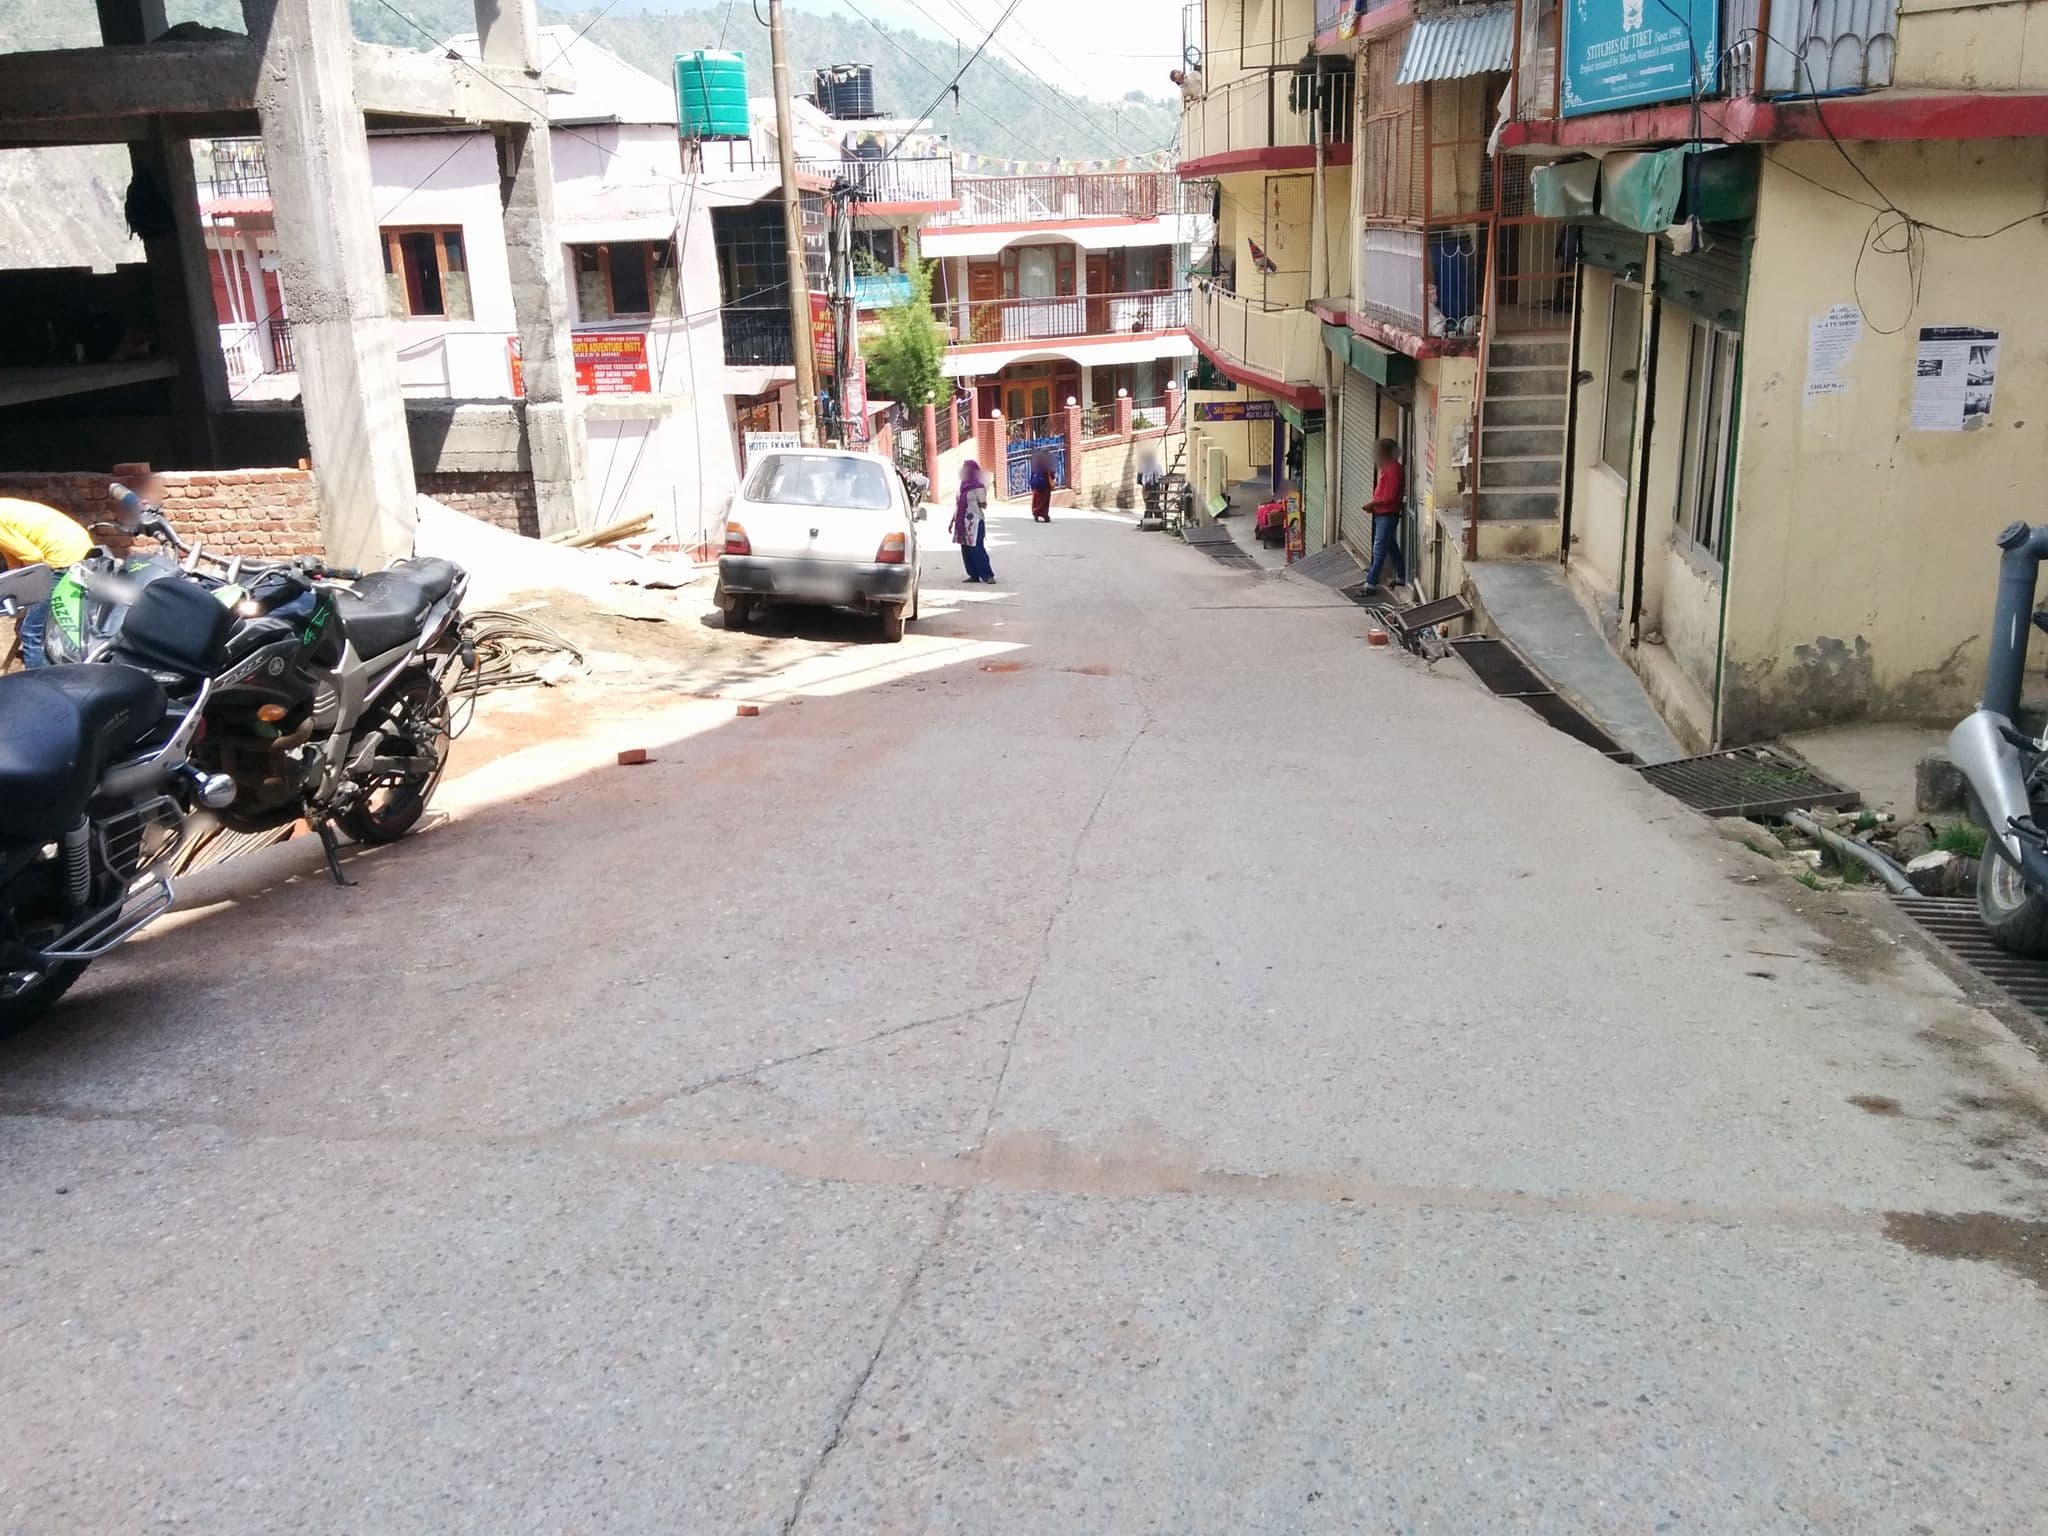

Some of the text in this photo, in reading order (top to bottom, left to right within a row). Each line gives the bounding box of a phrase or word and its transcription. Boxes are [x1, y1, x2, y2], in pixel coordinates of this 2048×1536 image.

[1587, 38, 1619, 60] STITCHES
[1620, 36, 1630, 51] OF
[1631, 29, 1653, 48] TIBET
[588, 341, 623, 353] ADVENTURE
[748, 442, 769, 451] HOTEL
[52, 595, 81, 632] FAZER
